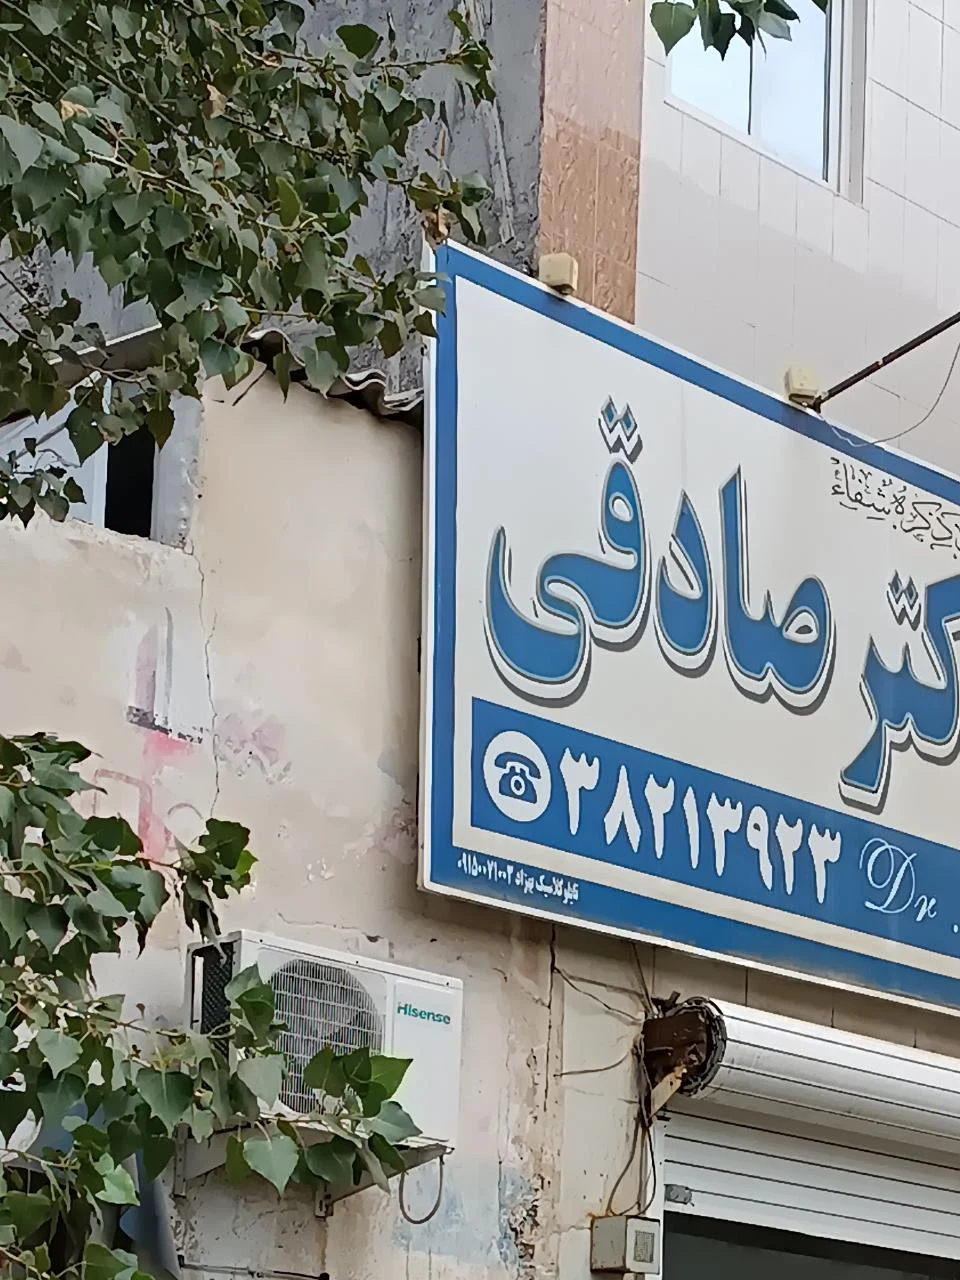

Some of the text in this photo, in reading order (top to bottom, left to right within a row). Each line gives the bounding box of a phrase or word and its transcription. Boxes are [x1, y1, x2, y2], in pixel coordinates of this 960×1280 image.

[484, 394, 837, 716] صادقی
[559, 747, 842, 904] ۳۸۲۱۳۹۲۳
[397, 1001, 451, 1025] Hisense
